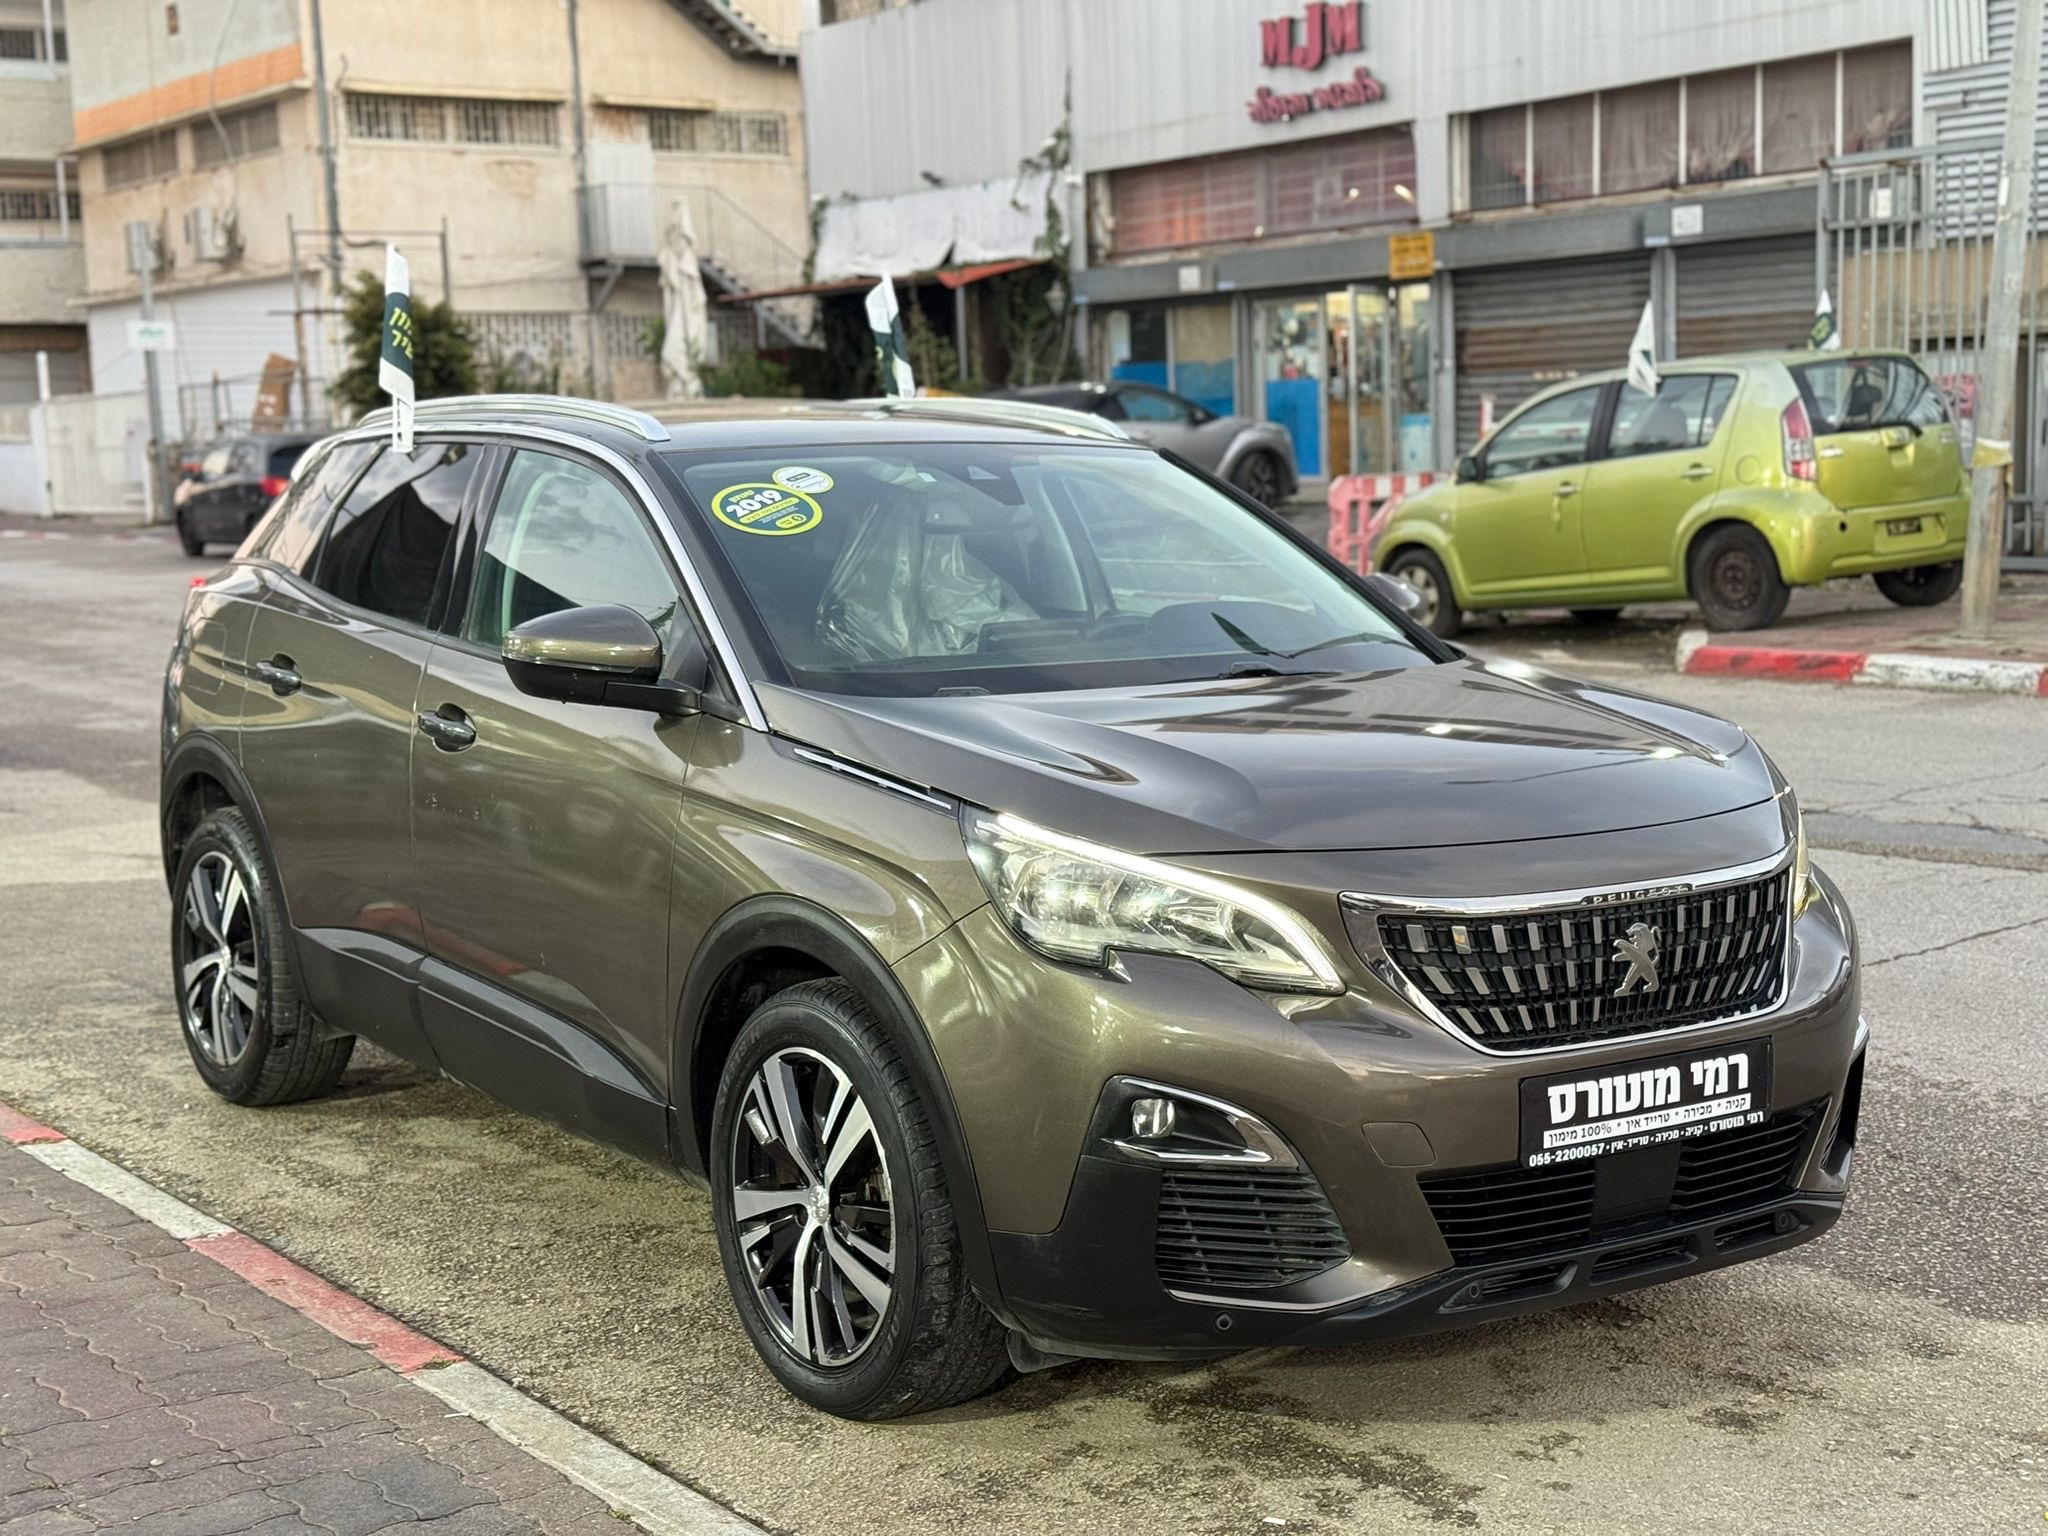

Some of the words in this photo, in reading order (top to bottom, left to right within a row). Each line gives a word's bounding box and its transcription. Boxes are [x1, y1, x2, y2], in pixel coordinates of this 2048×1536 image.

[1259, 0, 1362, 71] MJM
[725, 489, 782, 517] 2019
[1593, 885, 1688, 905] PEUGEOT
[1690, 1052, 1749, 1097] רמי
[1547, 1065, 1681, 1124] מוטורס
[1684, 1104, 1713, 1119] מכירה
[1725, 1097, 1746, 1111] קניה
[1626, 1118, 1641, 1132] אין
[1644, 1112, 1670, 1127] טרייד
[1709, 1115, 1744, 1132] מוטורס
[1747, 1111, 1763, 1124] רמי
[1549, 1129, 1577, 1146] מימון
[1581, 1122, 1612, 1138] 100%
[1655, 1129, 1679, 1143] מכירה
[1685, 1124, 1703, 1137] קניה
[1529, 1143, 1605, 1167] 055-2200057
